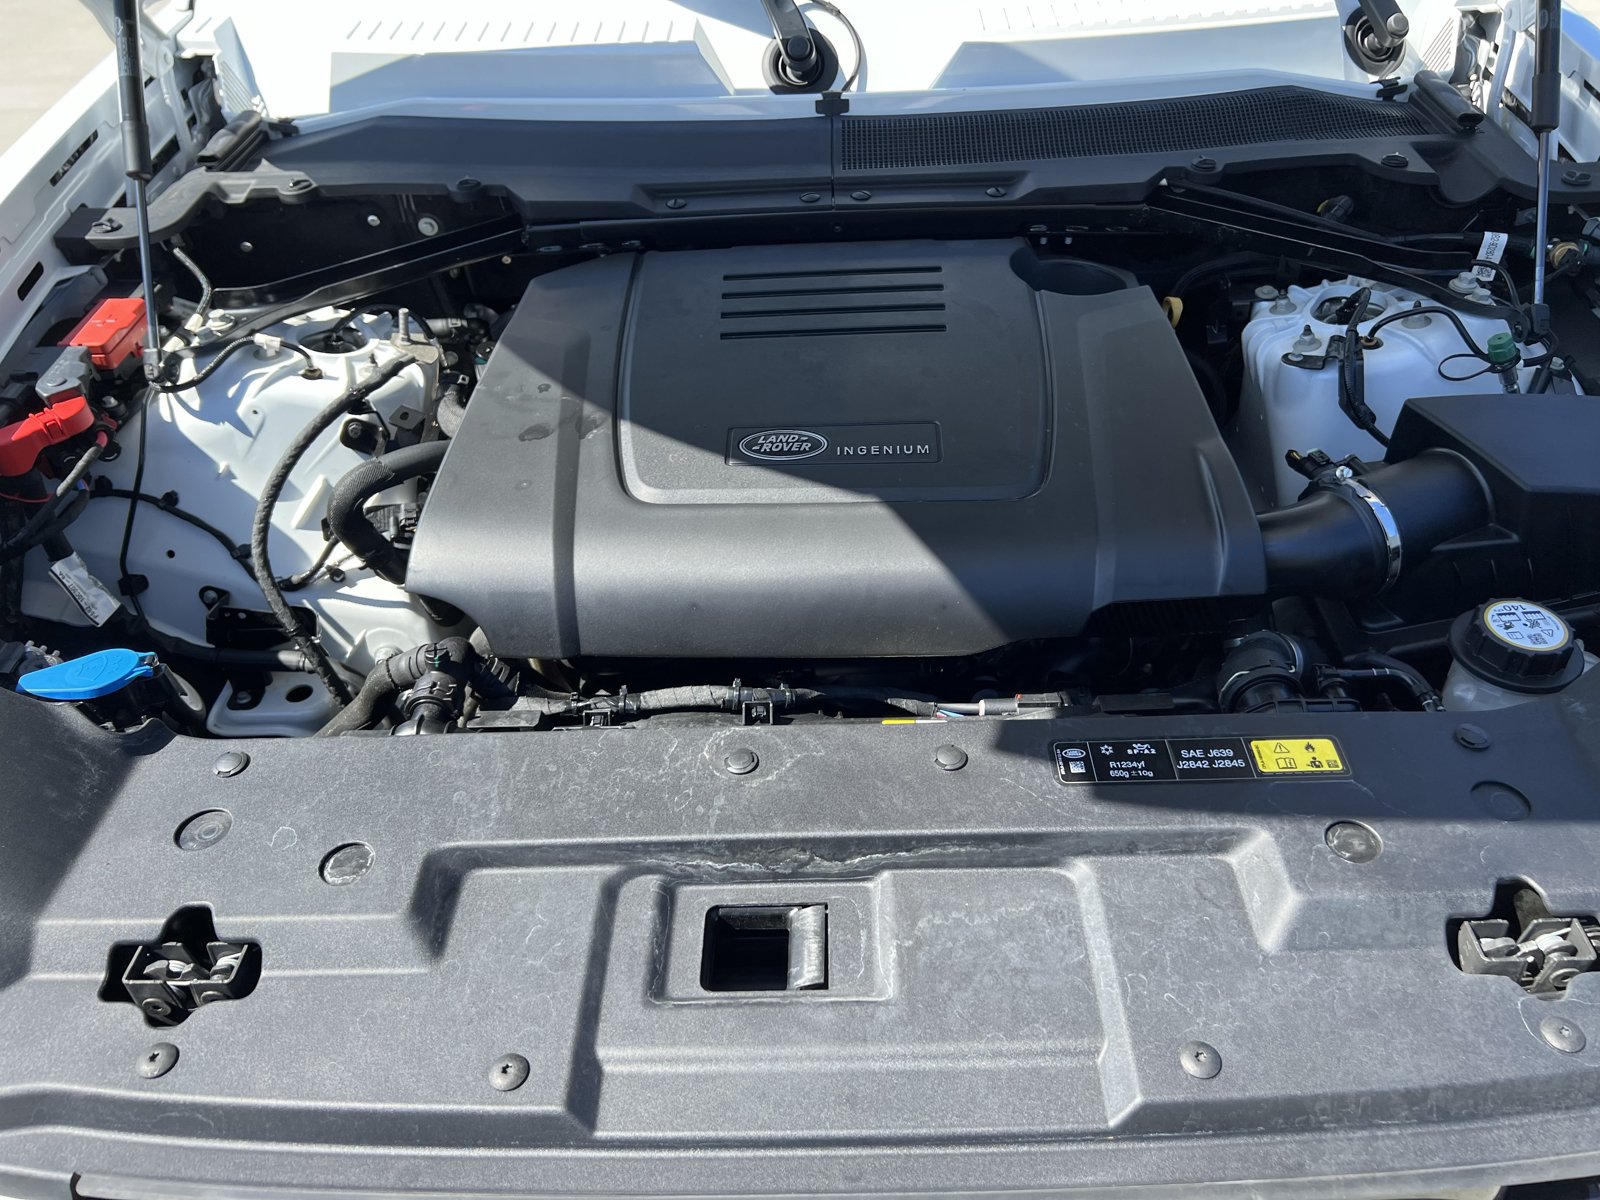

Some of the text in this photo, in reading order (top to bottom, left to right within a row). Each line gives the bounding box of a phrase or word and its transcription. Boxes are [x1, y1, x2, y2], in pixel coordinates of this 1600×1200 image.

[757, 434, 799, 444] LAND
[760, 442, 812, 452] ROVER
[836, 444, 930, 456] INGENIUM
[1503, 604, 1527, 612] 140
[1180, 748, 1234, 758] SAE J639
[1109, 760, 1146, 769] R1234yf
[1176, 759, 1246, 769] J2842 J2845
[1109, 769, 1130, 778] 650g
